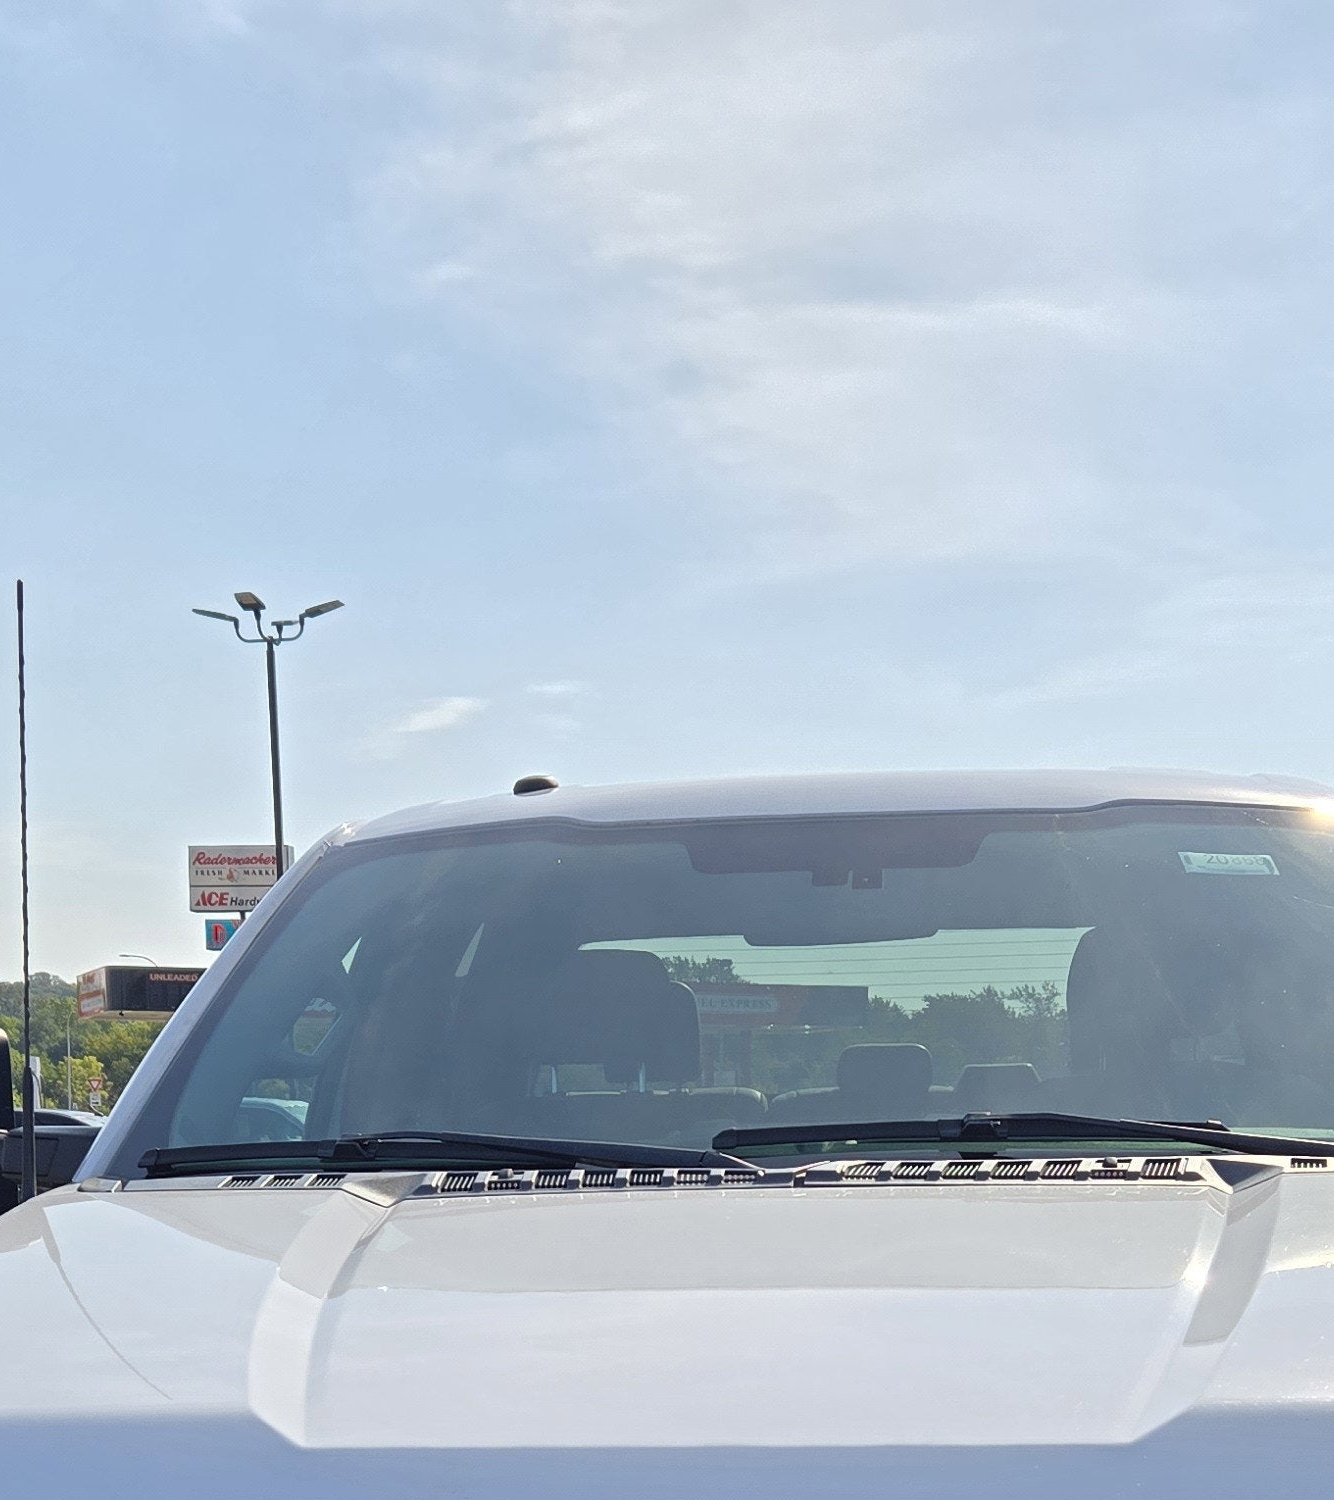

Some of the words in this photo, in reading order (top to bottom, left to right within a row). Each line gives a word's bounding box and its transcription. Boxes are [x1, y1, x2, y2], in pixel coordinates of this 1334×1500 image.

[192, 851, 276, 866] Radermacher
[194, 890, 229, 907] ACE
[149, 973, 198, 982] UNLEADED
